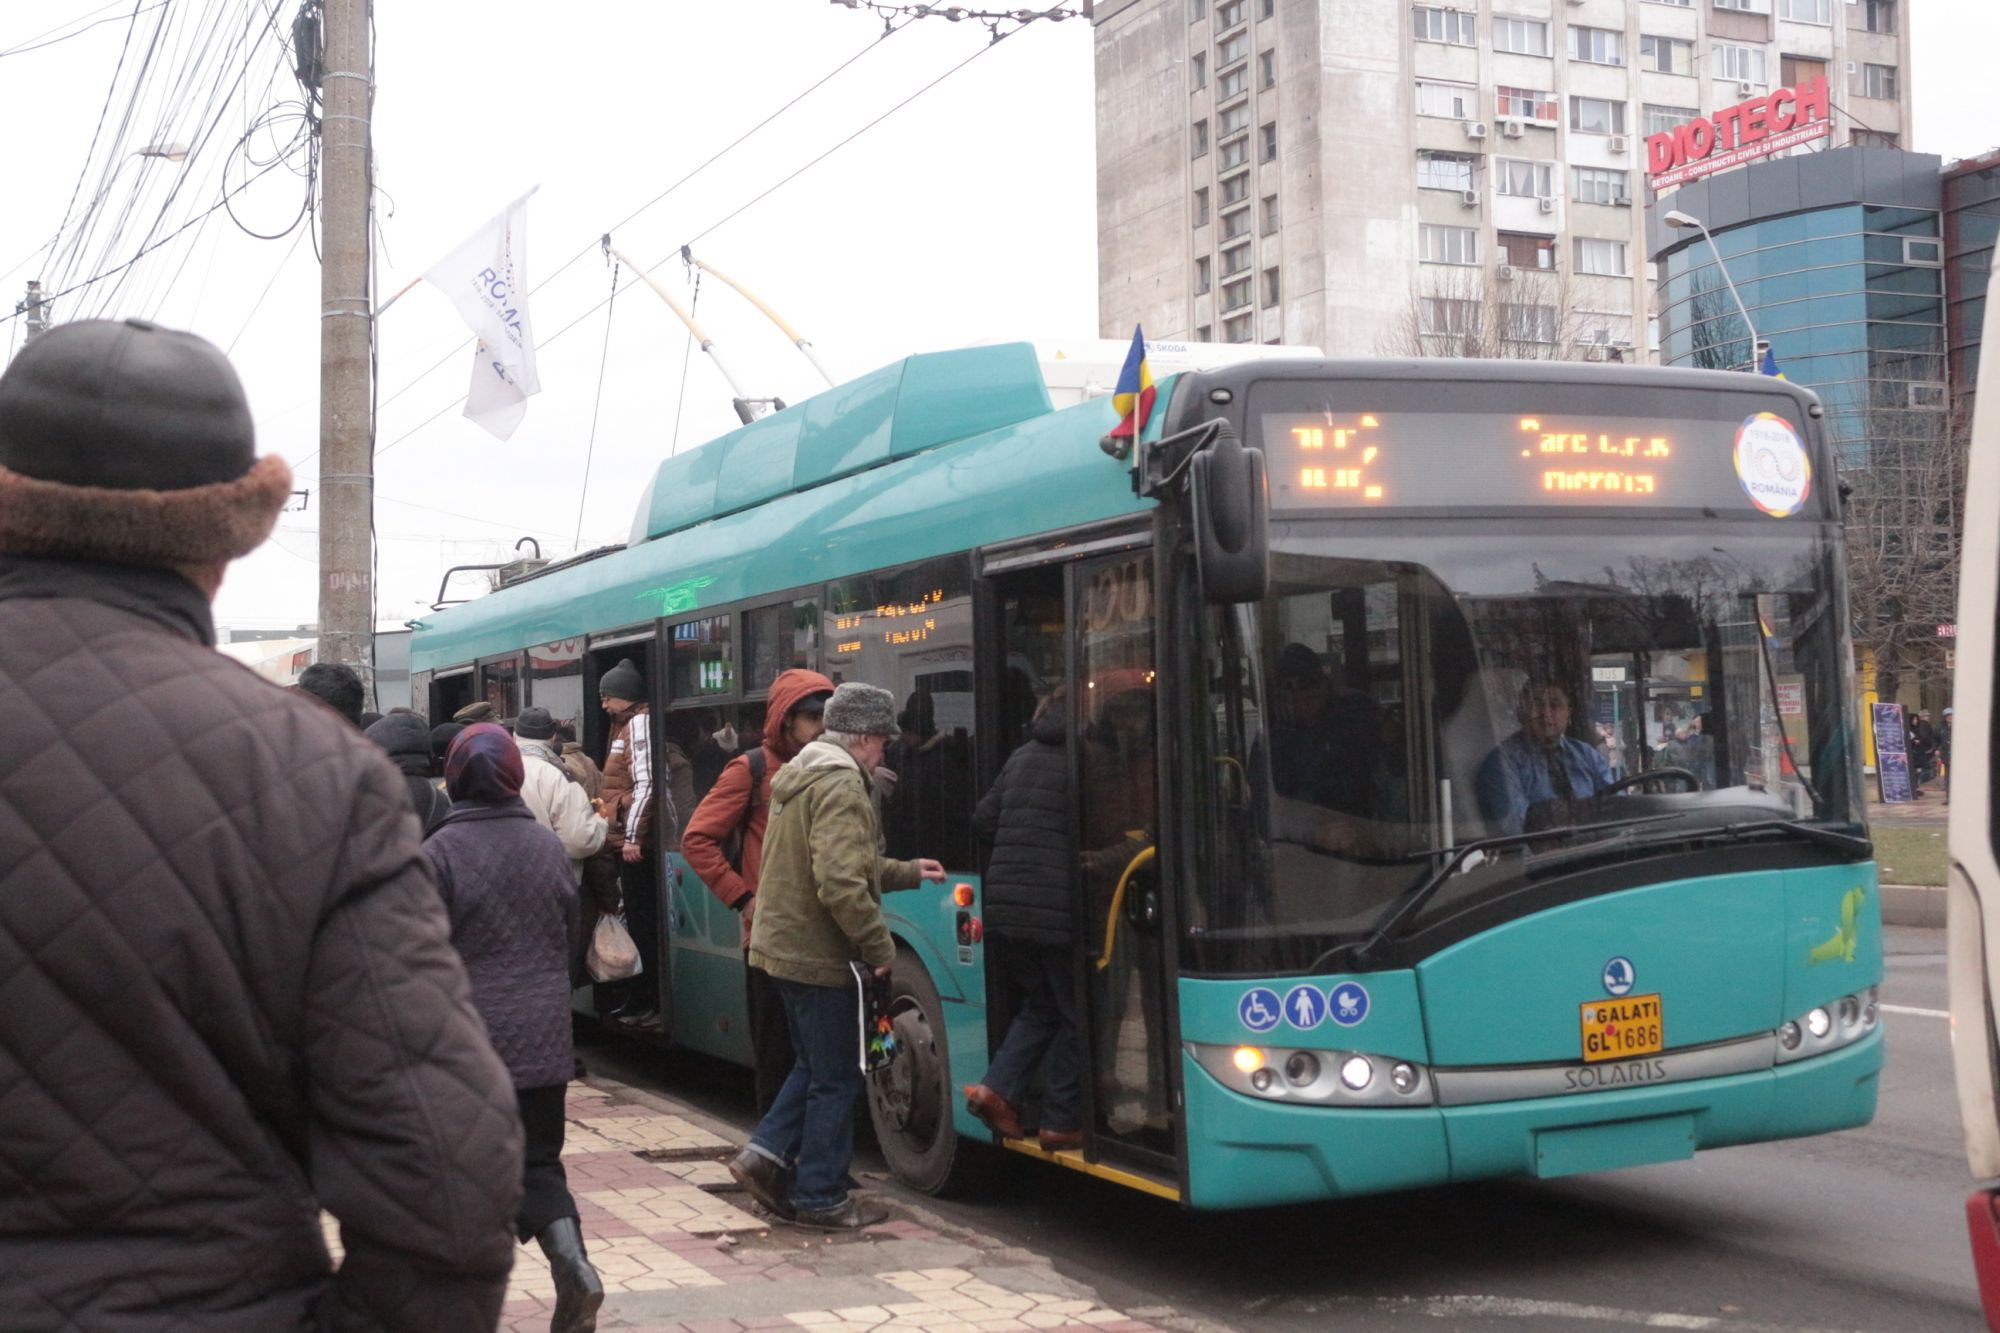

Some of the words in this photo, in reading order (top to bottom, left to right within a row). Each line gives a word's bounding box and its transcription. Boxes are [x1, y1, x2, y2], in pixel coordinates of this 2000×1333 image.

[1647, 75, 1829, 176] DIOTECH
[1688, 155, 1736, 177] CONSTRUCTII
[1737, 147, 1761, 161] CIVILE
[1772, 125, 1824, 149] INDUSTRIALE
[1596, 1002, 1658, 1024] GALATI
[1587, 1032, 1611, 1053] GL
[1614, 1024, 1659, 1051] 1686
[1565, 1060, 1667, 1090] SOLARIS
